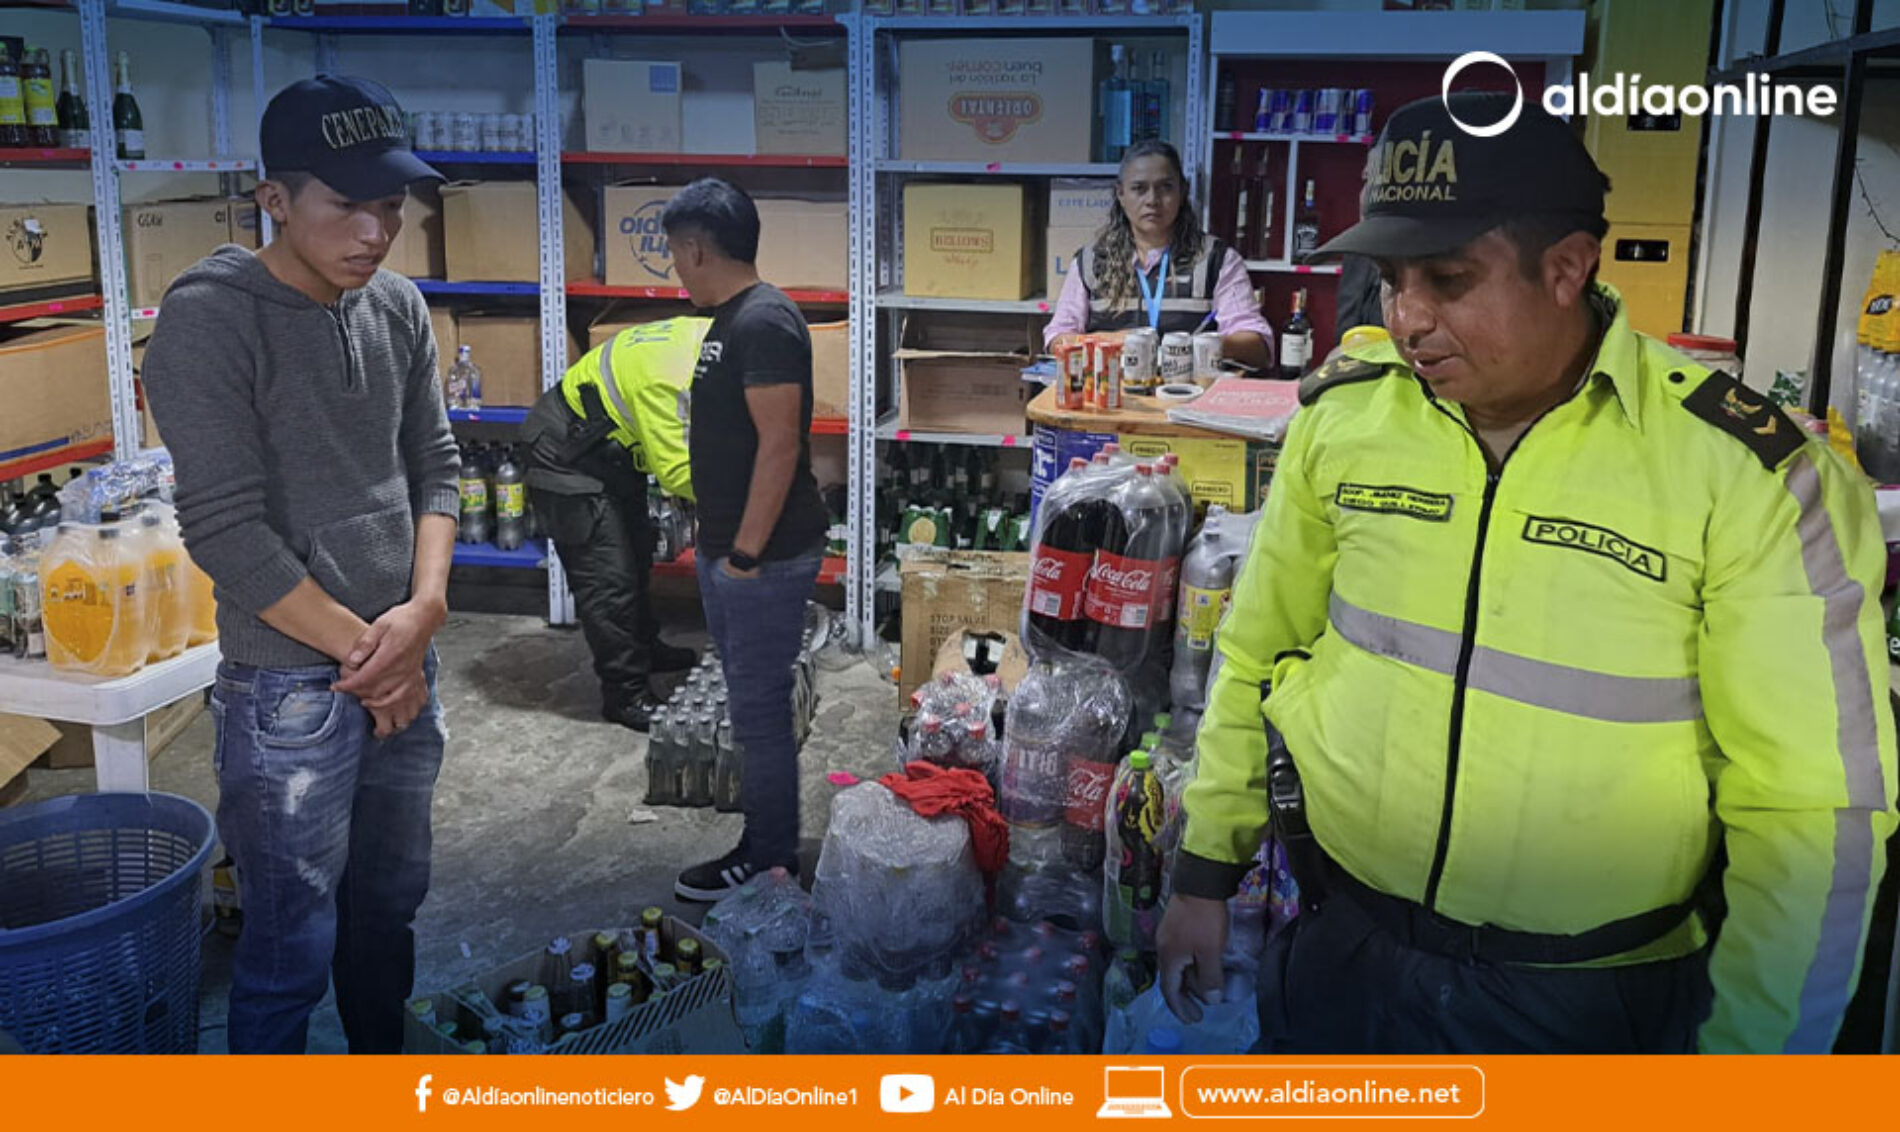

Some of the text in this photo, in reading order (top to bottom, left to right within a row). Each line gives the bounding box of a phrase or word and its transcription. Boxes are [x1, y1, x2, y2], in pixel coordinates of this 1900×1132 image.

[959, 98, 1033, 116] ORIENTAL
[1370, 185, 1457, 202] NACIONAL
[1535, 524, 1651, 571] POLICIA
